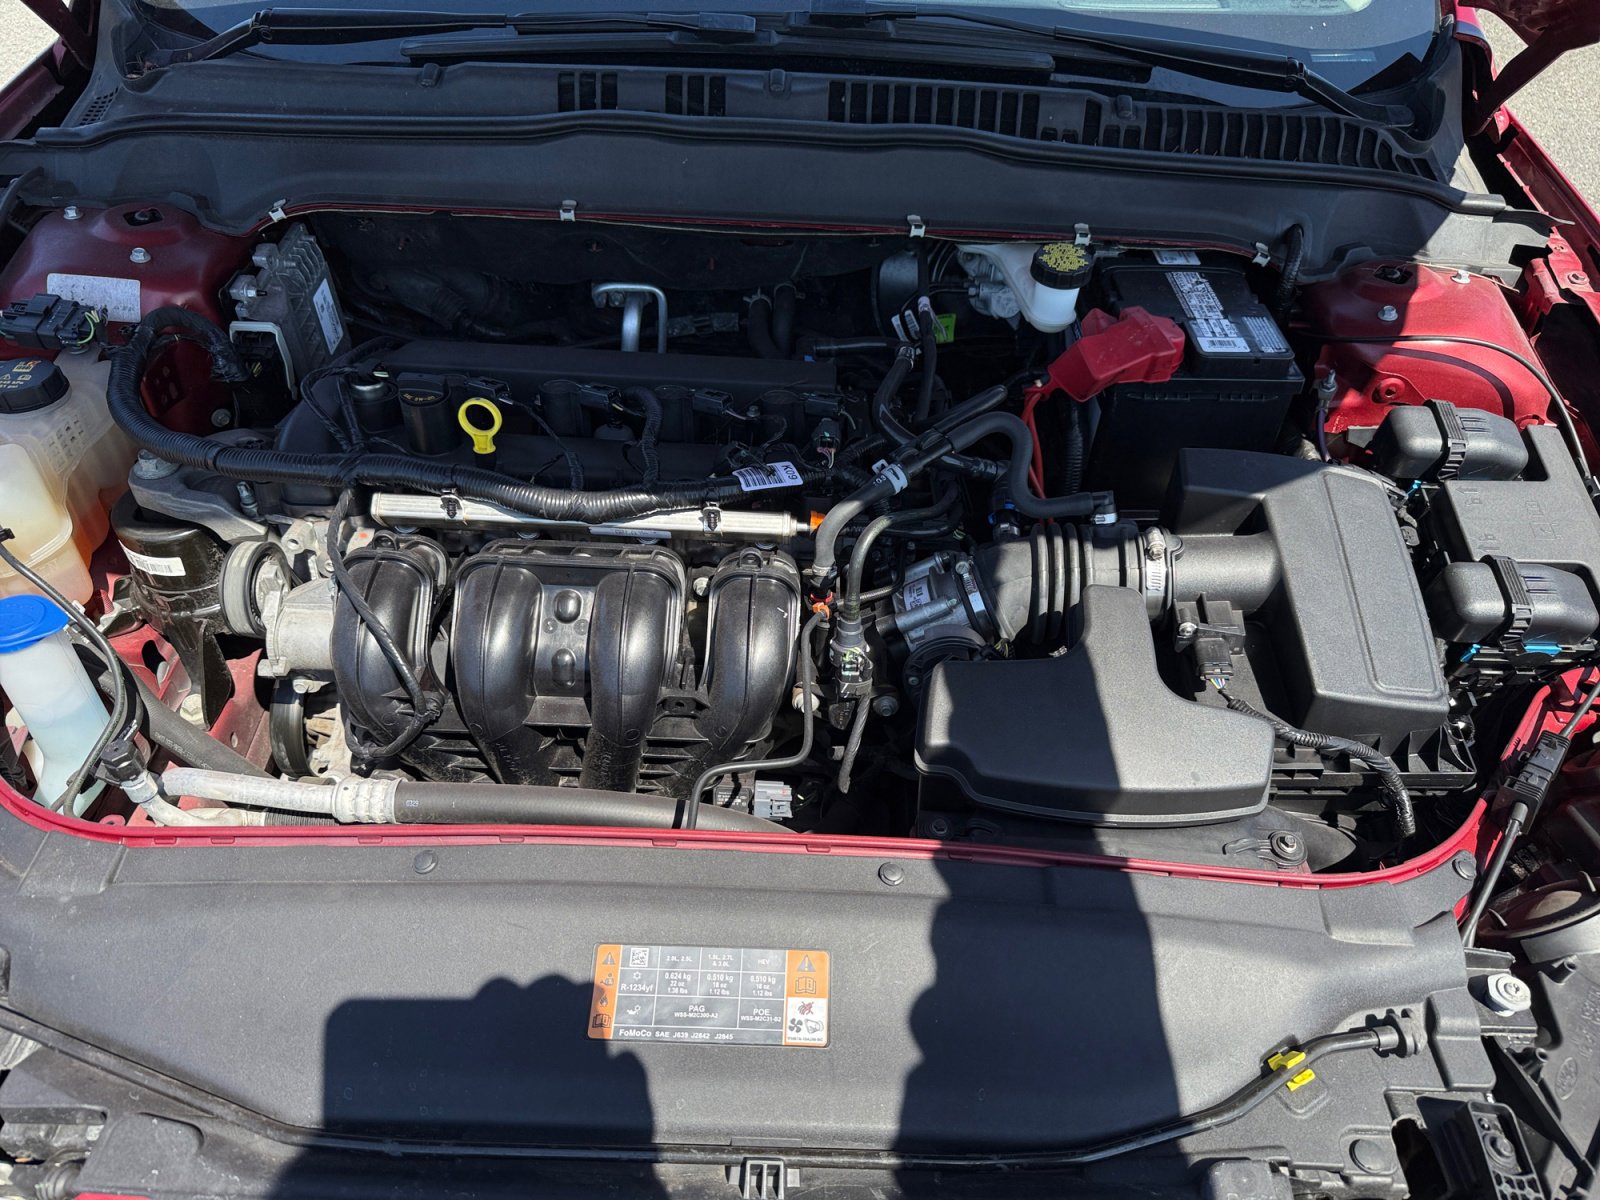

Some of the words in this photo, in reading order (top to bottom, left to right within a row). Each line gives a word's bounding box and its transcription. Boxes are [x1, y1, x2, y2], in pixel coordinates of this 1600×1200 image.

[781, 464, 798, 480] K09
[664, 972, 681, 980] 0.624
[682, 972, 692, 981] kg
[706, 973, 724, 981] 0.510
[725, 974, 734, 983] kg
[750, 975, 767, 983] 0.510
[767, 975, 776, 984] kg
[620, 983, 654, 993] R-1234yf
[688, 1005, 706, 1013] PAG
[753, 1008, 771, 1016] POE
[618, 1029, 652, 1038] FoMoCo
[672, 1031, 689, 1039] J639
